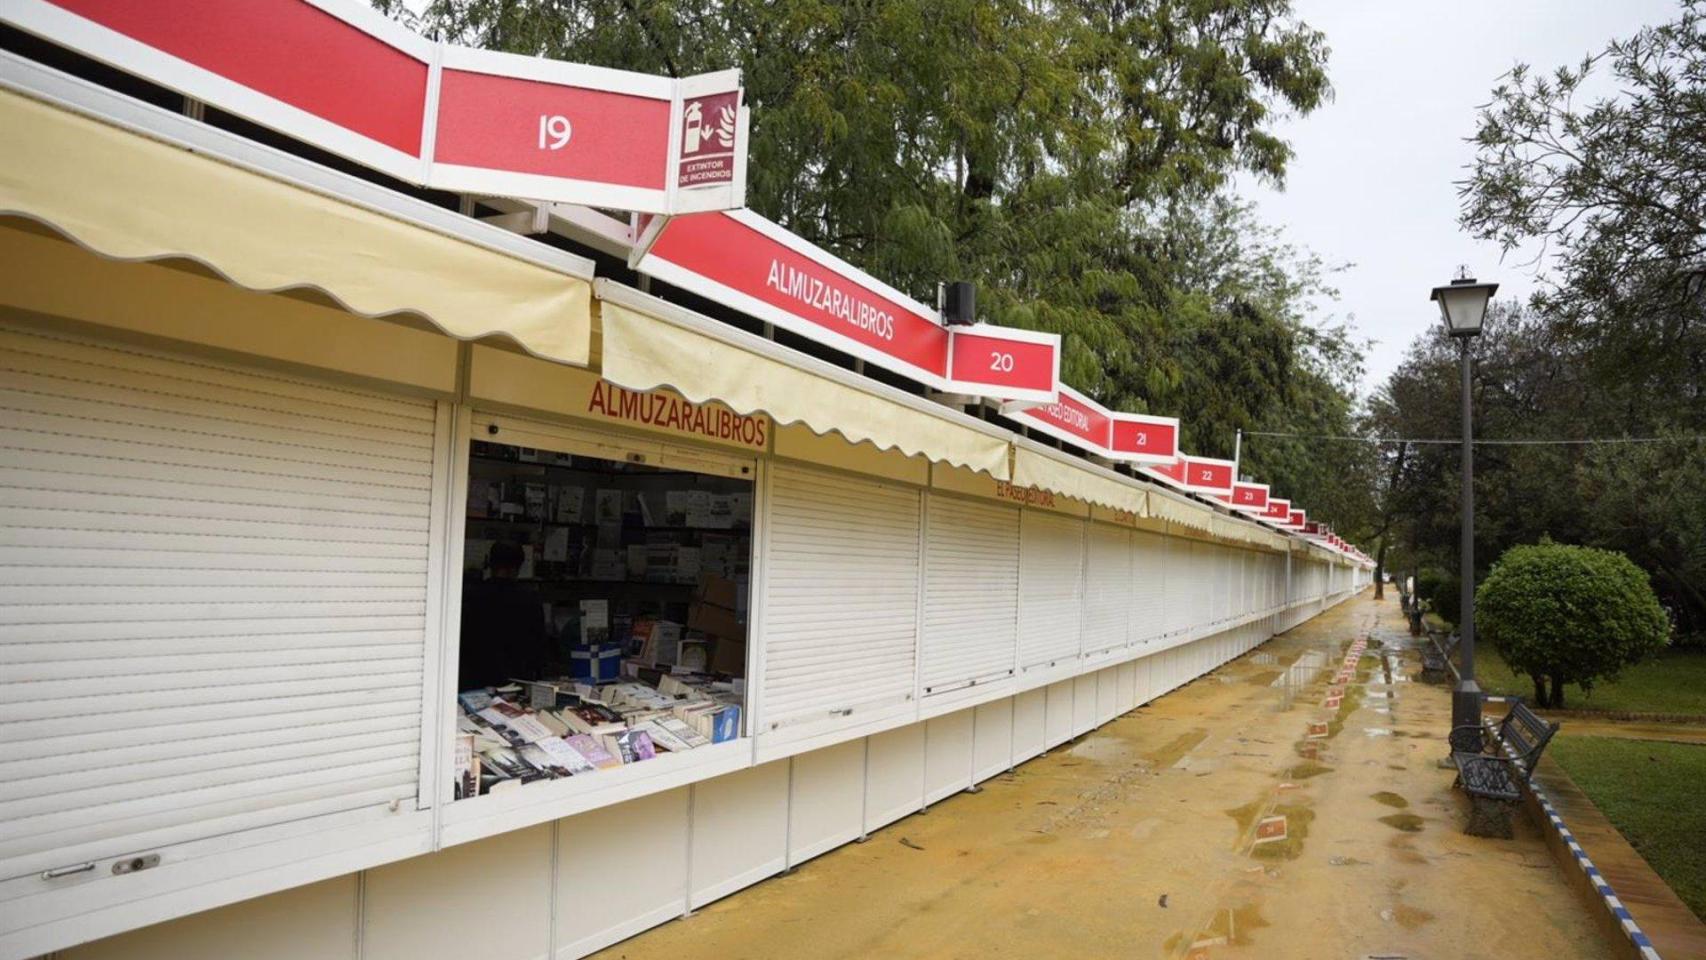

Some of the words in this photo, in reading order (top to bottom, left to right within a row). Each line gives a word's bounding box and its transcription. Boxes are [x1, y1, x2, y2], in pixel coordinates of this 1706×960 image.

[539, 115, 571, 150] 19
[687, 160, 724, 172] EXTINTOR
[680, 174, 689, 183] DE
[690, 169, 731, 181] INCENDIOS
[766, 259, 894, 341] ALMUZARALIBROS
[990, 352, 1014, 372] 20
[588, 381, 766, 447] ALMUZARALIBROS
[1136, 432, 1147, 446] 21
[1202, 470, 1213, 481] 22
[1244, 492, 1254, 501] 23
